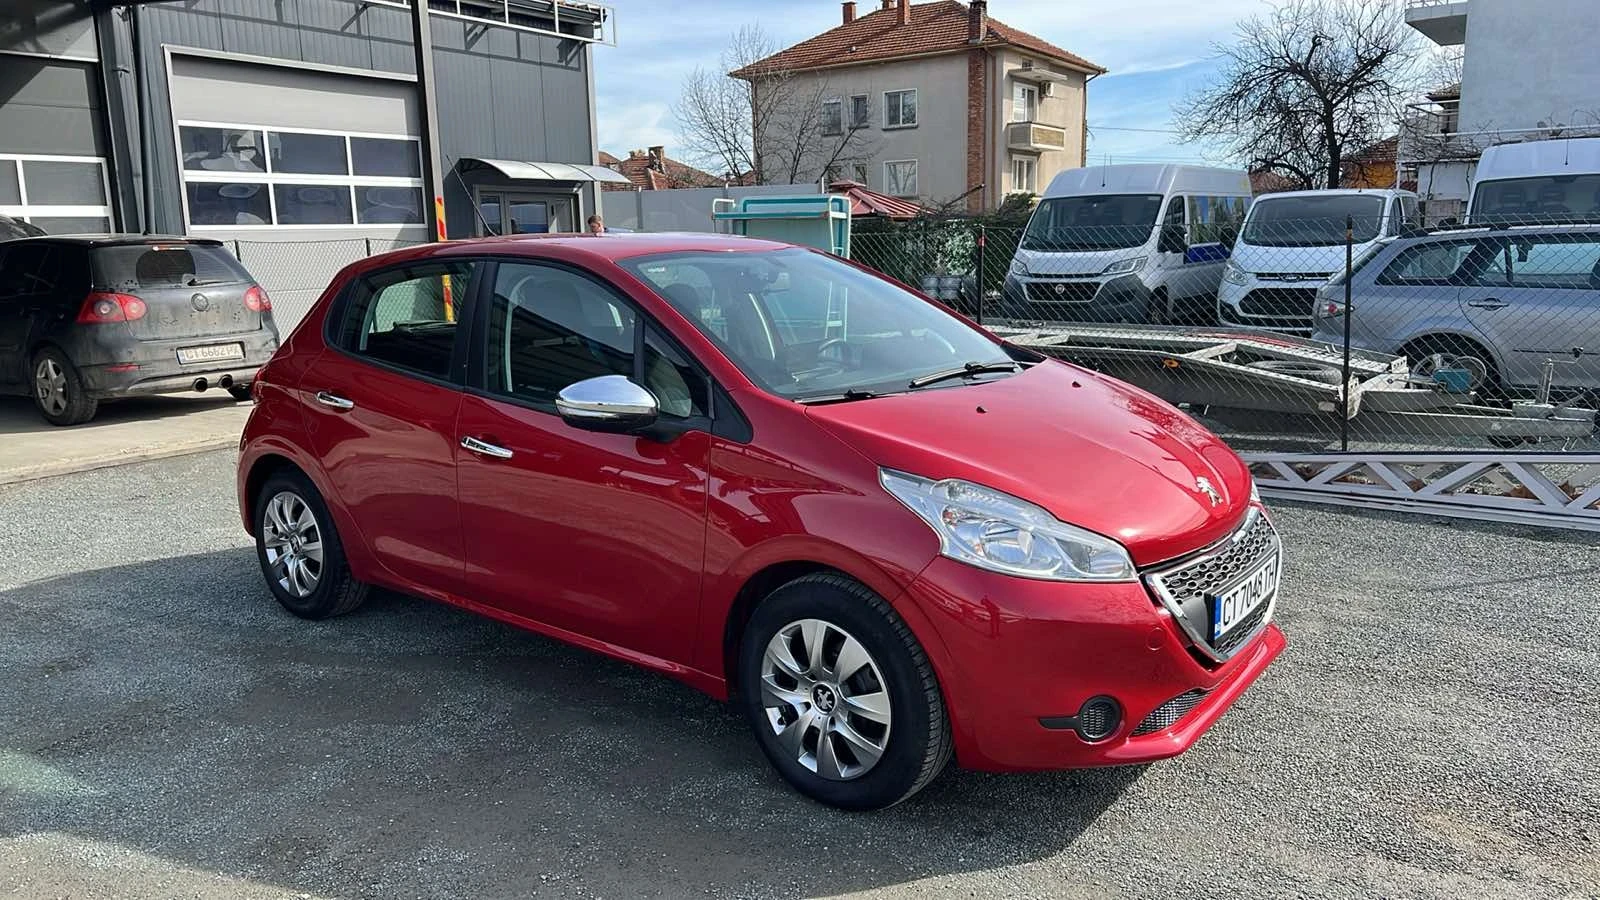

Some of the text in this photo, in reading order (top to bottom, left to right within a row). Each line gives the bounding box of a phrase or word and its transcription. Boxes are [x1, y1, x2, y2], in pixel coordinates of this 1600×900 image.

[1223, 561, 1275, 626] CT 7048 TH
